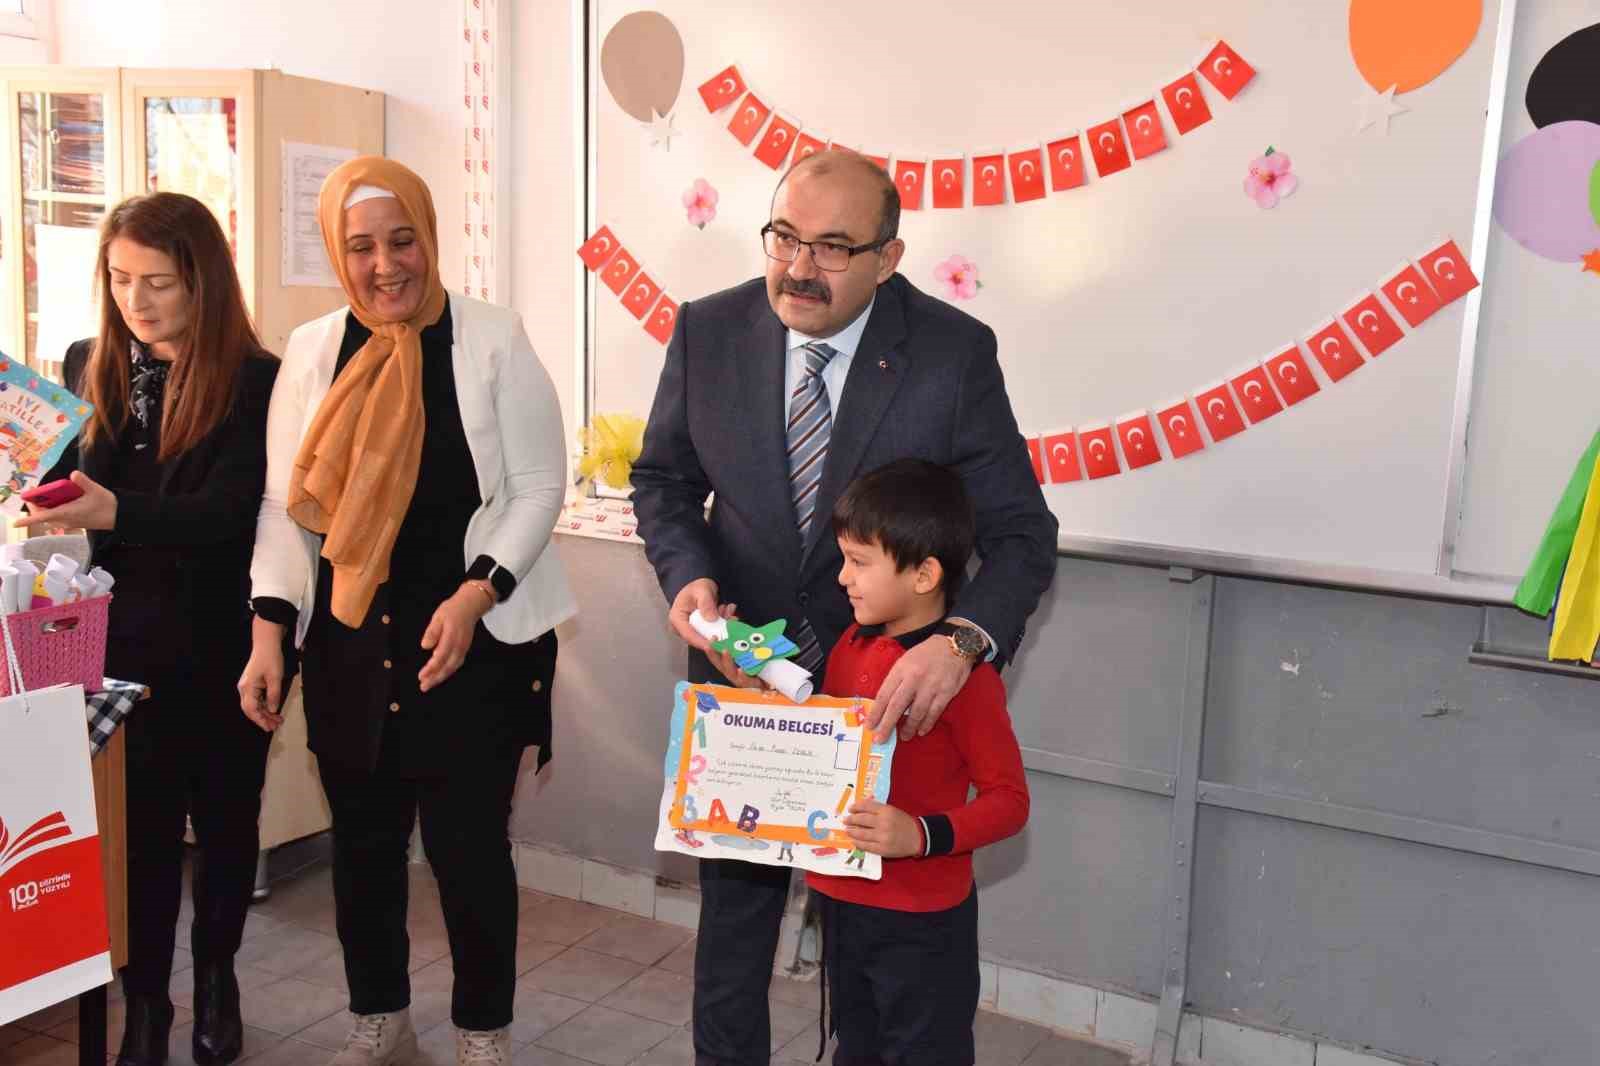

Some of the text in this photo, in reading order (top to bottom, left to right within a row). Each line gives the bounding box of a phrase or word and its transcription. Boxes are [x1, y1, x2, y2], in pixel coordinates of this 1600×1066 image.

[723, 713, 834, 737] OKUMA BELGESİ
[707, 798, 730, 827] A
[735, 804, 761, 833] B
[9, 881, 38, 912] 100
